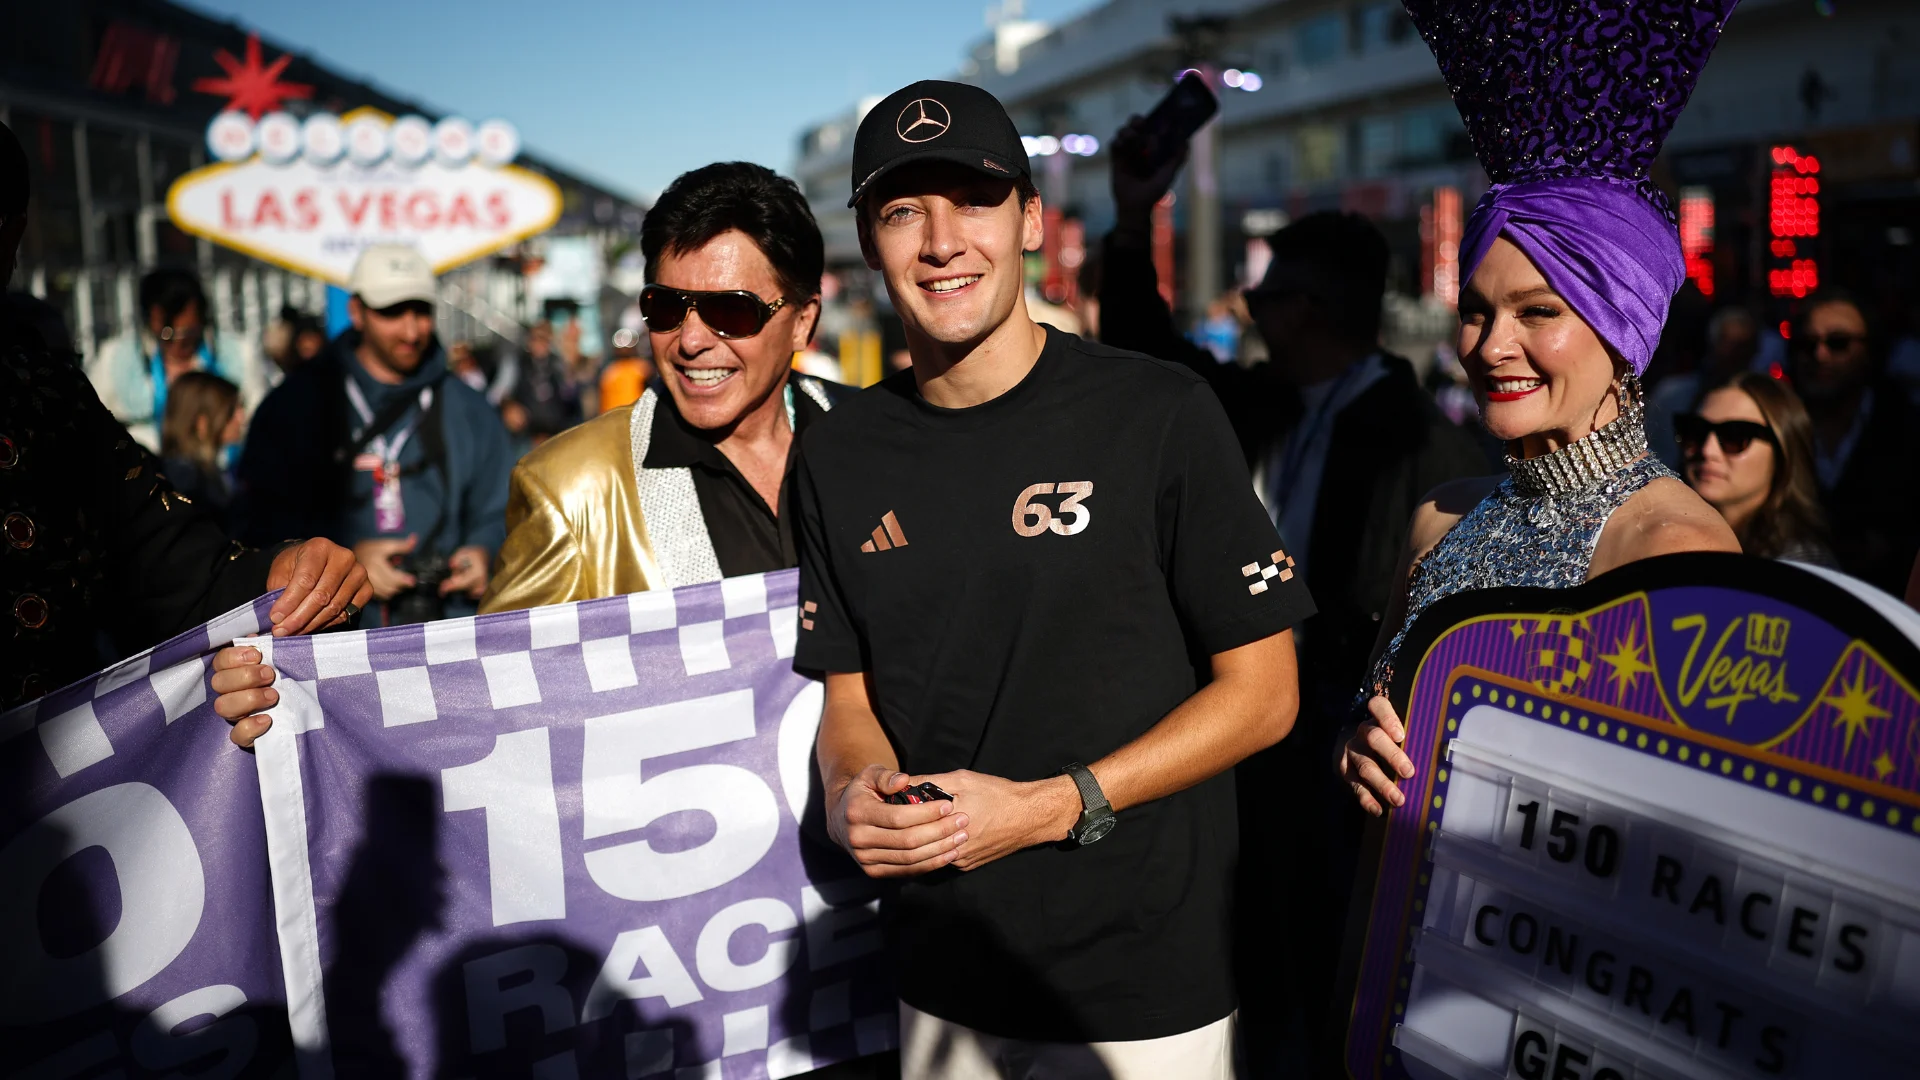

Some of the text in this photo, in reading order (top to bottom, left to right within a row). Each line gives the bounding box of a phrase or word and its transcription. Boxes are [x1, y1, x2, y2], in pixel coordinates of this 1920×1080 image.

[219, 186, 512, 231] LAS VEGAS
[1012, 480, 1094, 538] 63
[1746, 613, 1791, 658] LAS
[1671, 613, 1800, 726] Vegas
[1516, 800, 1870, 976] 150 RACES
[1474, 904, 1790, 1075] CONGRATS
[1514, 1030, 1623, 1080] GE
